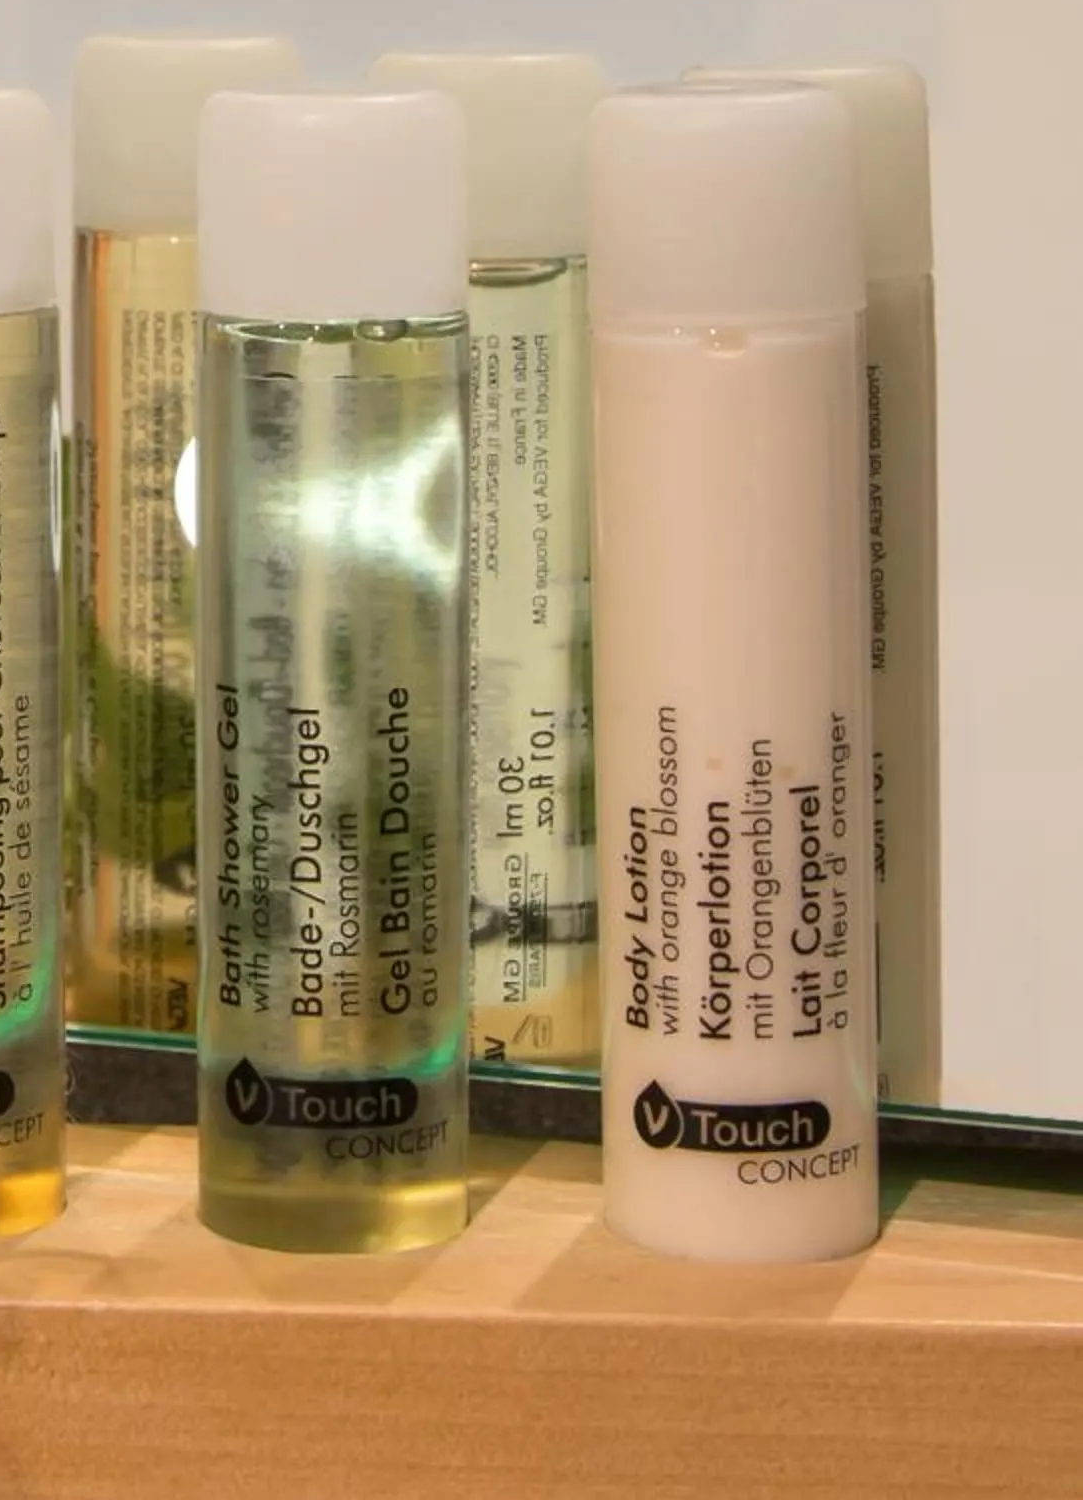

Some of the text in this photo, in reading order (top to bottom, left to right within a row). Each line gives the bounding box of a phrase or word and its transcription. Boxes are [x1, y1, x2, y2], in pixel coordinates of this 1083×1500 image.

[8, 823, 30, 860] de
[10, 695, 31, 811] sésame
[216, 684, 241, 1007] Bath Shower Gel
[376, 687, 411, 1014] Gel Bain Douche
[11, 873, 32, 946] huile
[245, 795, 274, 1013] with rosemary
[286, 708, 329, 1017] Bade-/Duschgel
[329, 813, 360, 1017] mit Rosmarin
[416, 833, 438, 1007] au romarin
[623, 807, 655, 1030] Body Lotion
[649, 707, 686, 1036] with orange blossom
[696, 801, 741, 1040] Körperlotion
[741, 740, 780, 1039] mit Orangenblüten
[789, 785, 827, 1038] Lait Corporel
[823, 712, 850, 1029] à la fleur d' oranger
[13, 983, 34, 1001] à
[279, 1087, 402, 1123] Touch
[325, 1120, 448, 1160] CONCEPT
[690, 1109, 813, 1145] Touch
[737, 1143, 860, 1185] CONCEPT
